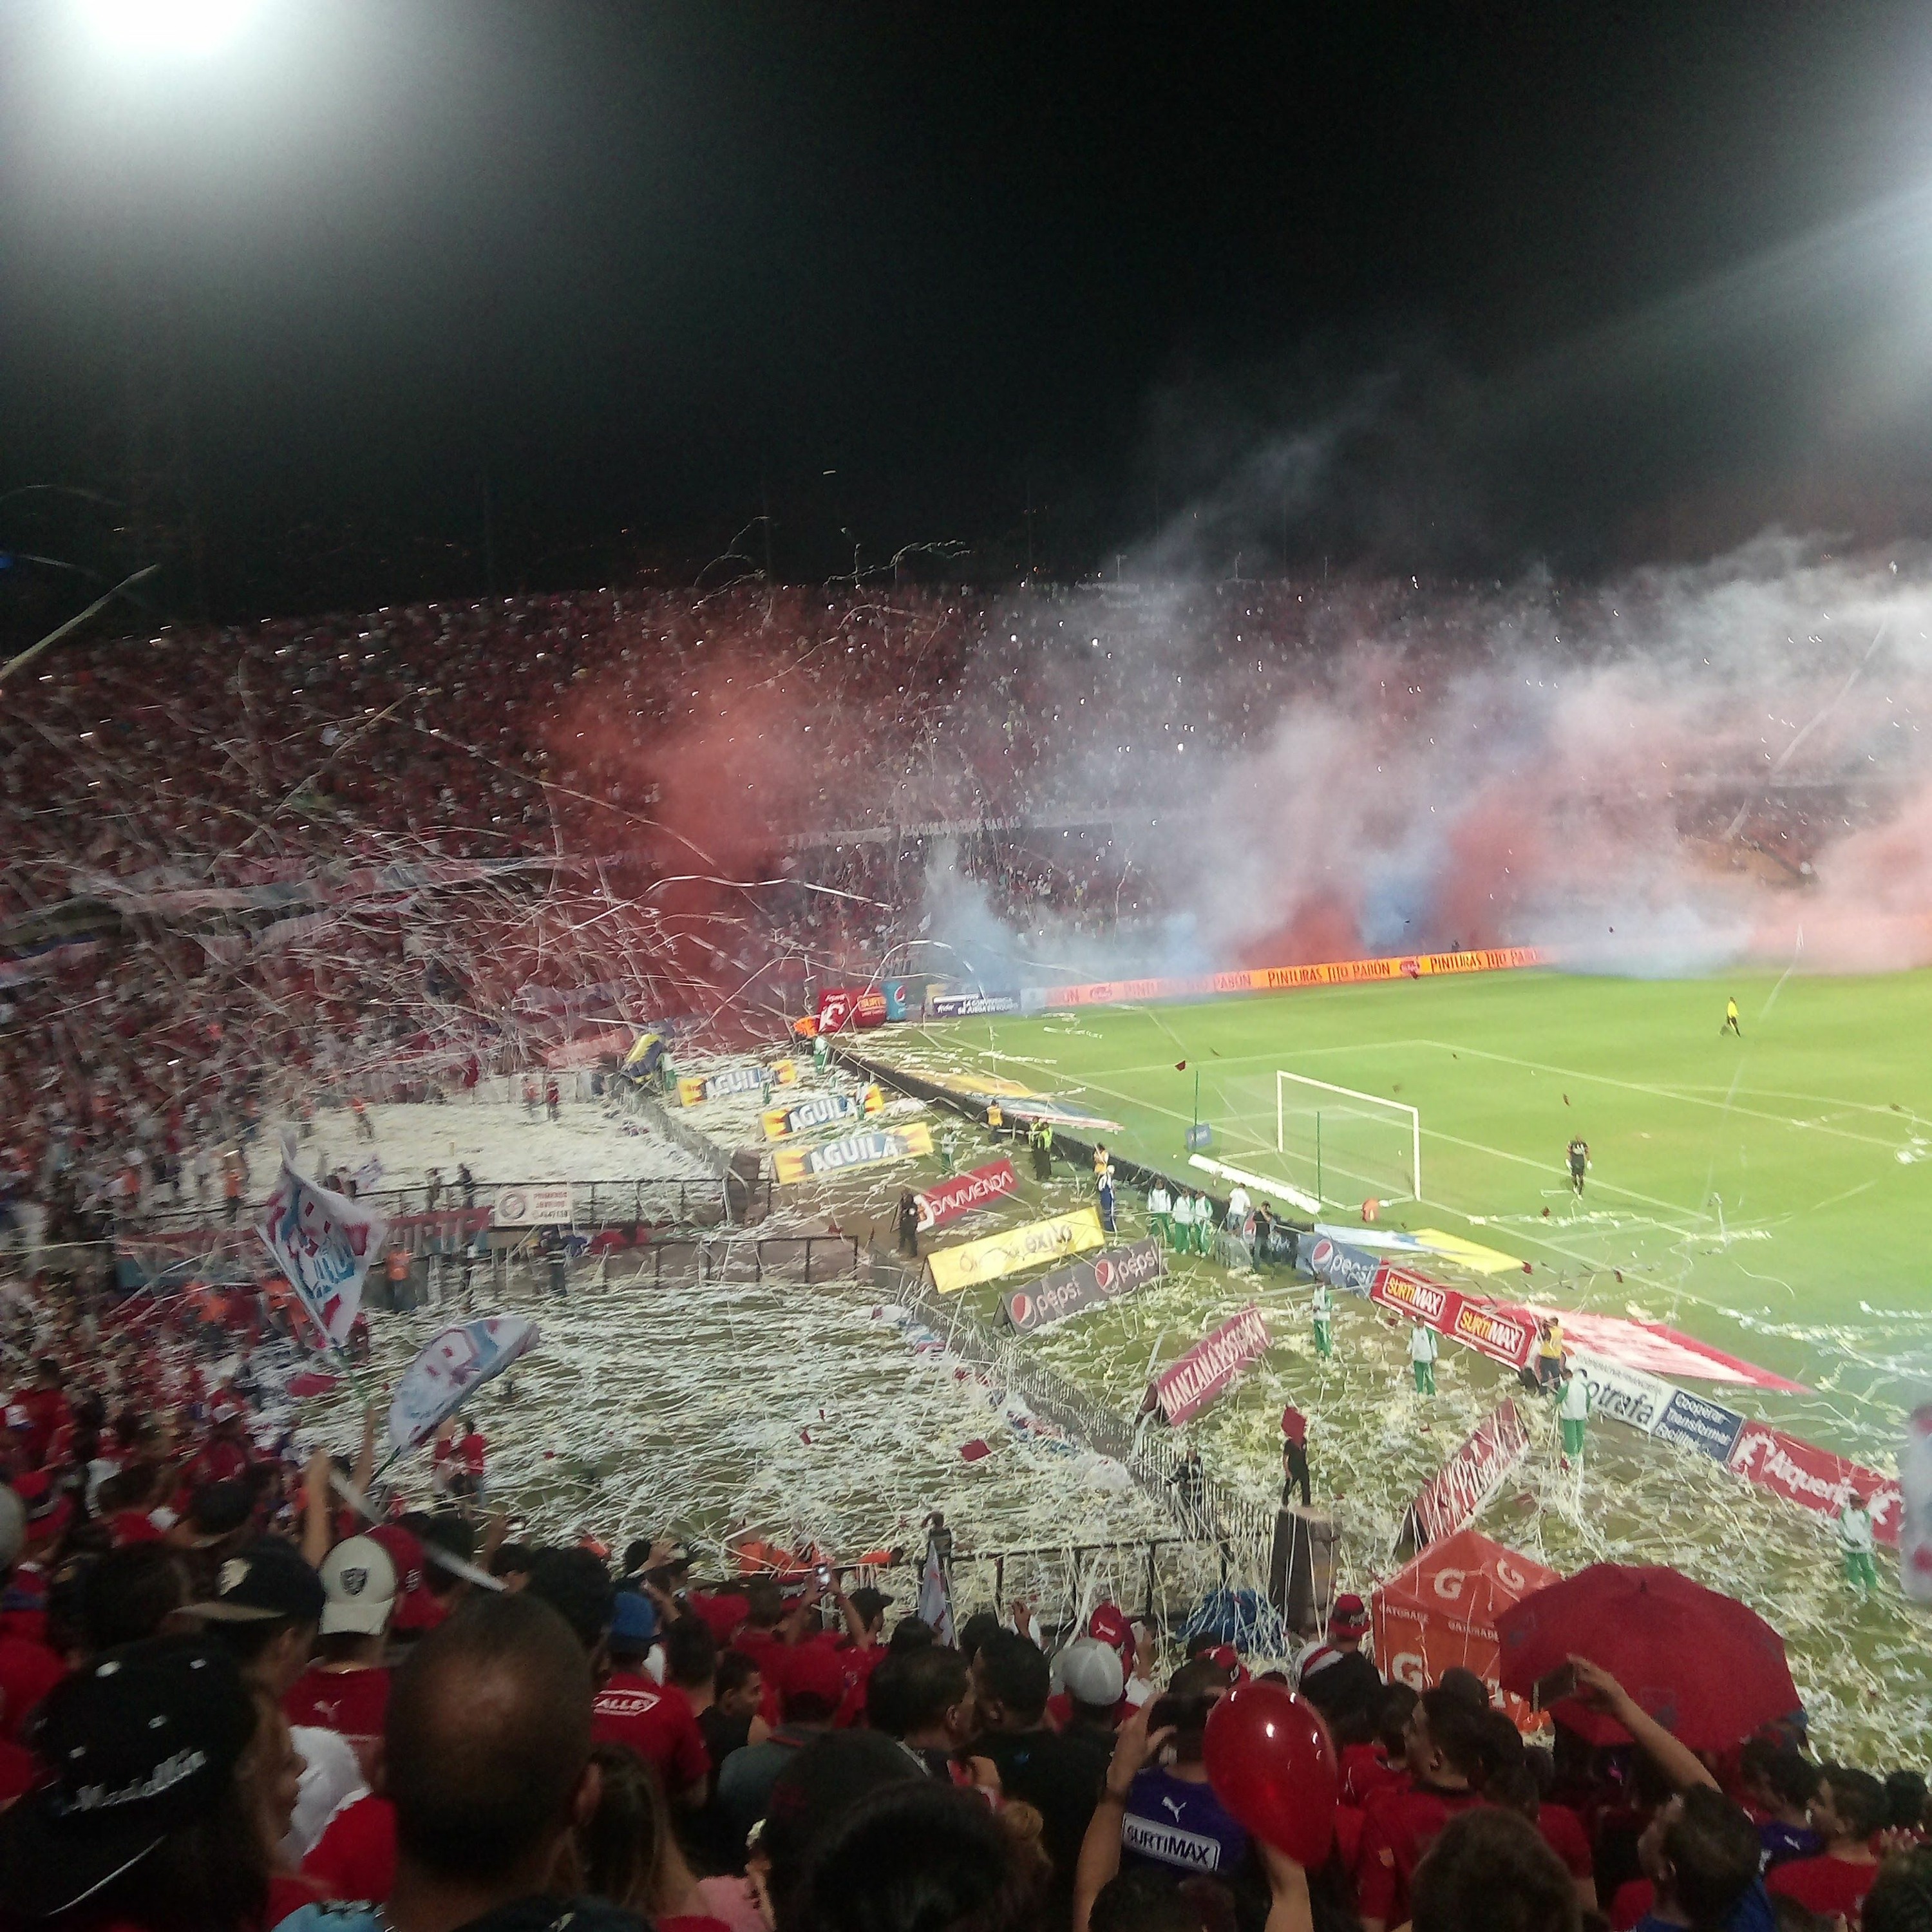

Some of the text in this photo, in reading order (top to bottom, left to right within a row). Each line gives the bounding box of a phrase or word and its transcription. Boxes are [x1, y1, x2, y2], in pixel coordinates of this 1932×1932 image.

[1268, 969, 1321, 987] PINTURAS
[1430, 956, 1481, 973] PINTURAS
[789, 1097, 858, 1132] AGUILA
[810, 1135, 900, 1173] AGUILA
[931, 1171, 1014, 1216] DAVIVIENDA
[1118, 1244, 1159, 1283] pepsi
[1036, 1282, 1083, 1318] pepsi
[1387, 1276, 1441, 1316] SURTIMAX
[1461, 1311, 1522, 1354] SURTIMAX
[1160, 1347, 1223, 1417] MANZANA
[1434, 1567, 1466, 1600] G
[1496, 1558, 1525, 1591] G
[1392, 1652, 1423, 1693] G
[1127, 1824, 1209, 1868] SURTIMAX
